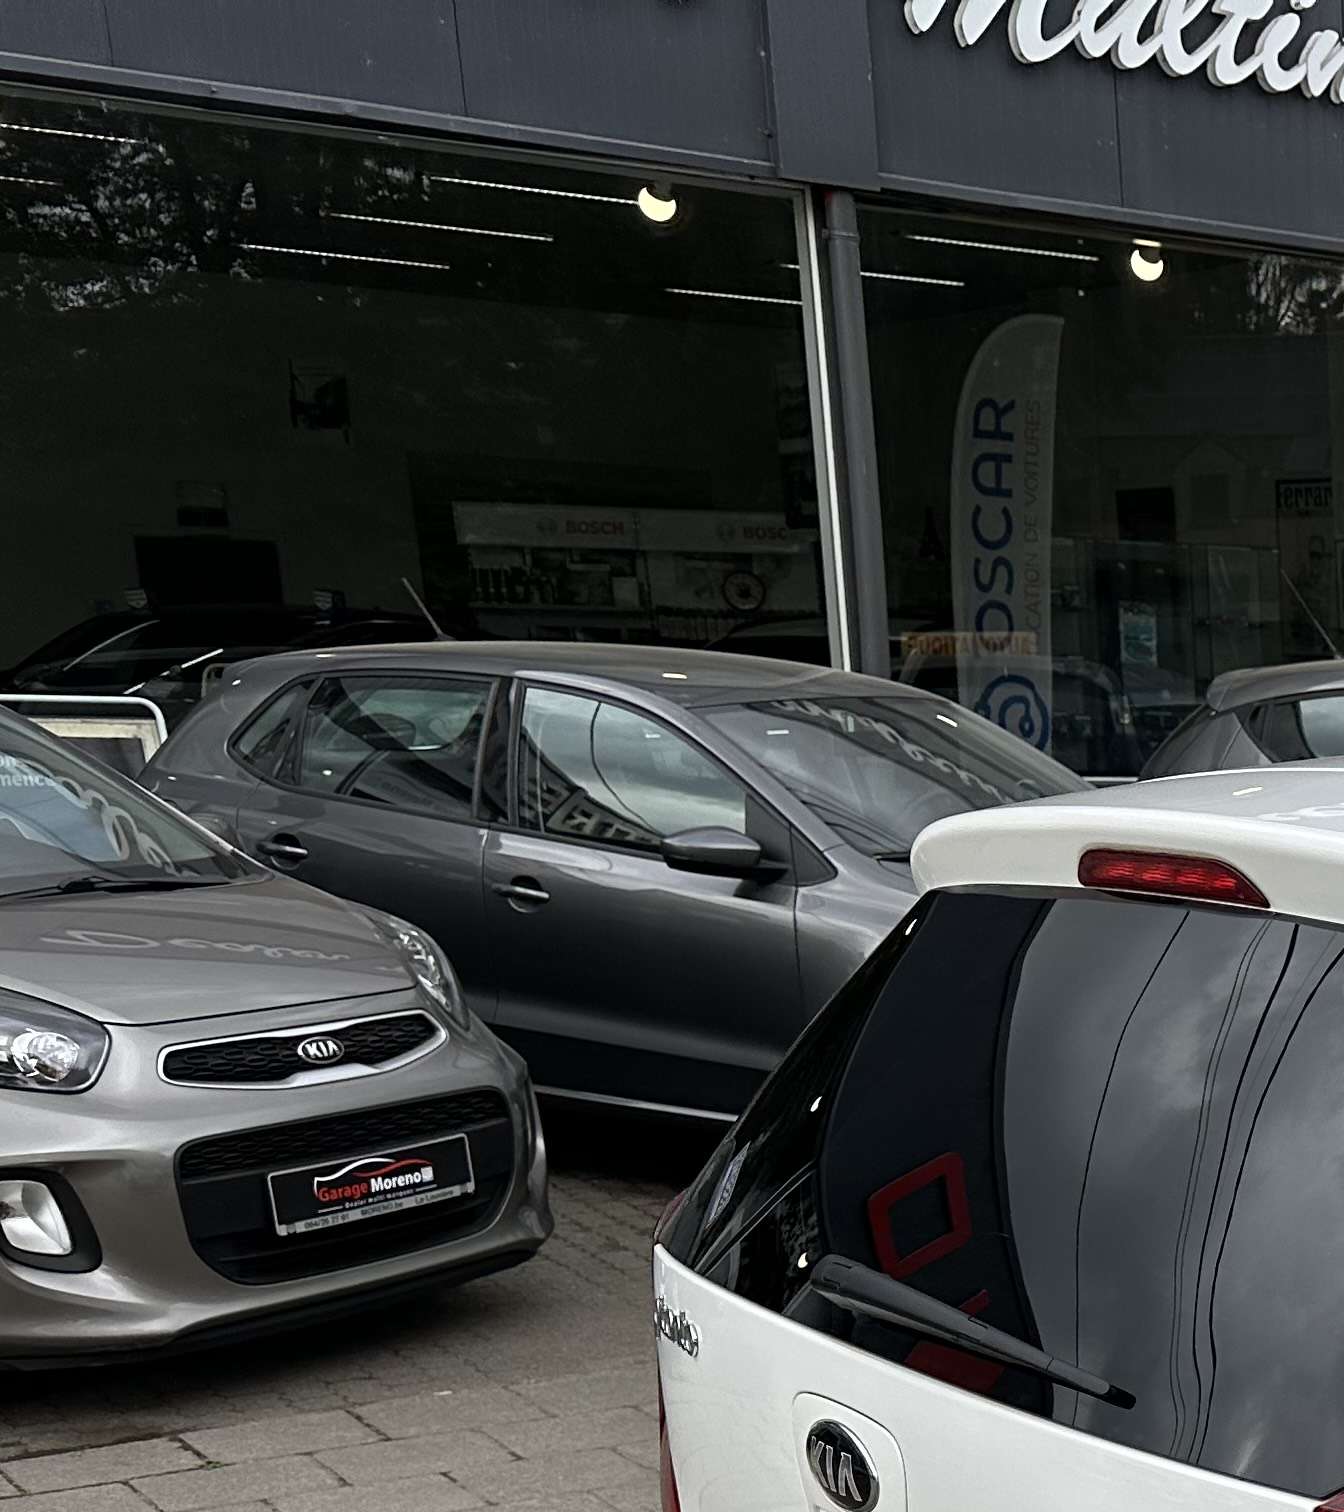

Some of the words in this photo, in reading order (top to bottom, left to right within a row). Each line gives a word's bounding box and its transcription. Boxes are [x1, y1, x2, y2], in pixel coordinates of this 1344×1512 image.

[743, 527, 787, 541] BOSC
[1023, 553, 1041, 650] CATION
[305, 1040, 340, 1058] KIA
[319, 1181, 369, 1202] Garage
[370, 1170, 421, 1193] Moreno
[811, 1435, 863, 1502] KIA
